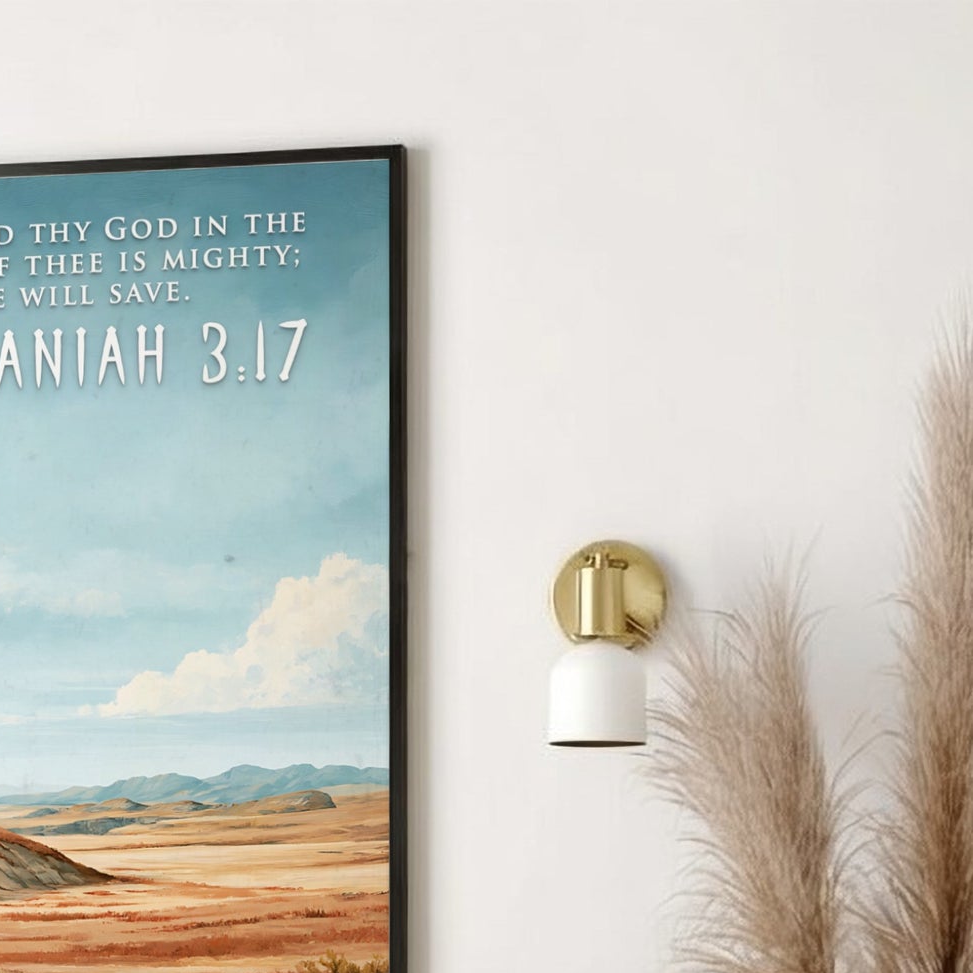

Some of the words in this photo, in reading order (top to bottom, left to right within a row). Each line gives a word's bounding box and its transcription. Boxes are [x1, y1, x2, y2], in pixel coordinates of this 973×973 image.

[30, 222, 90, 243] THY
[105, 217, 177, 240] GOD
[194, 216, 226, 236] IN
[244, 211, 306, 234] THE
[25, 253, 103, 276] THEE
[119, 251, 146, 273] IS
[163, 245, 301, 271] MIGHTY;
[20, 285, 94, 306] WILL
[110, 281, 191, 305] SAVE.
[202, 318, 307, 383] 3:17
